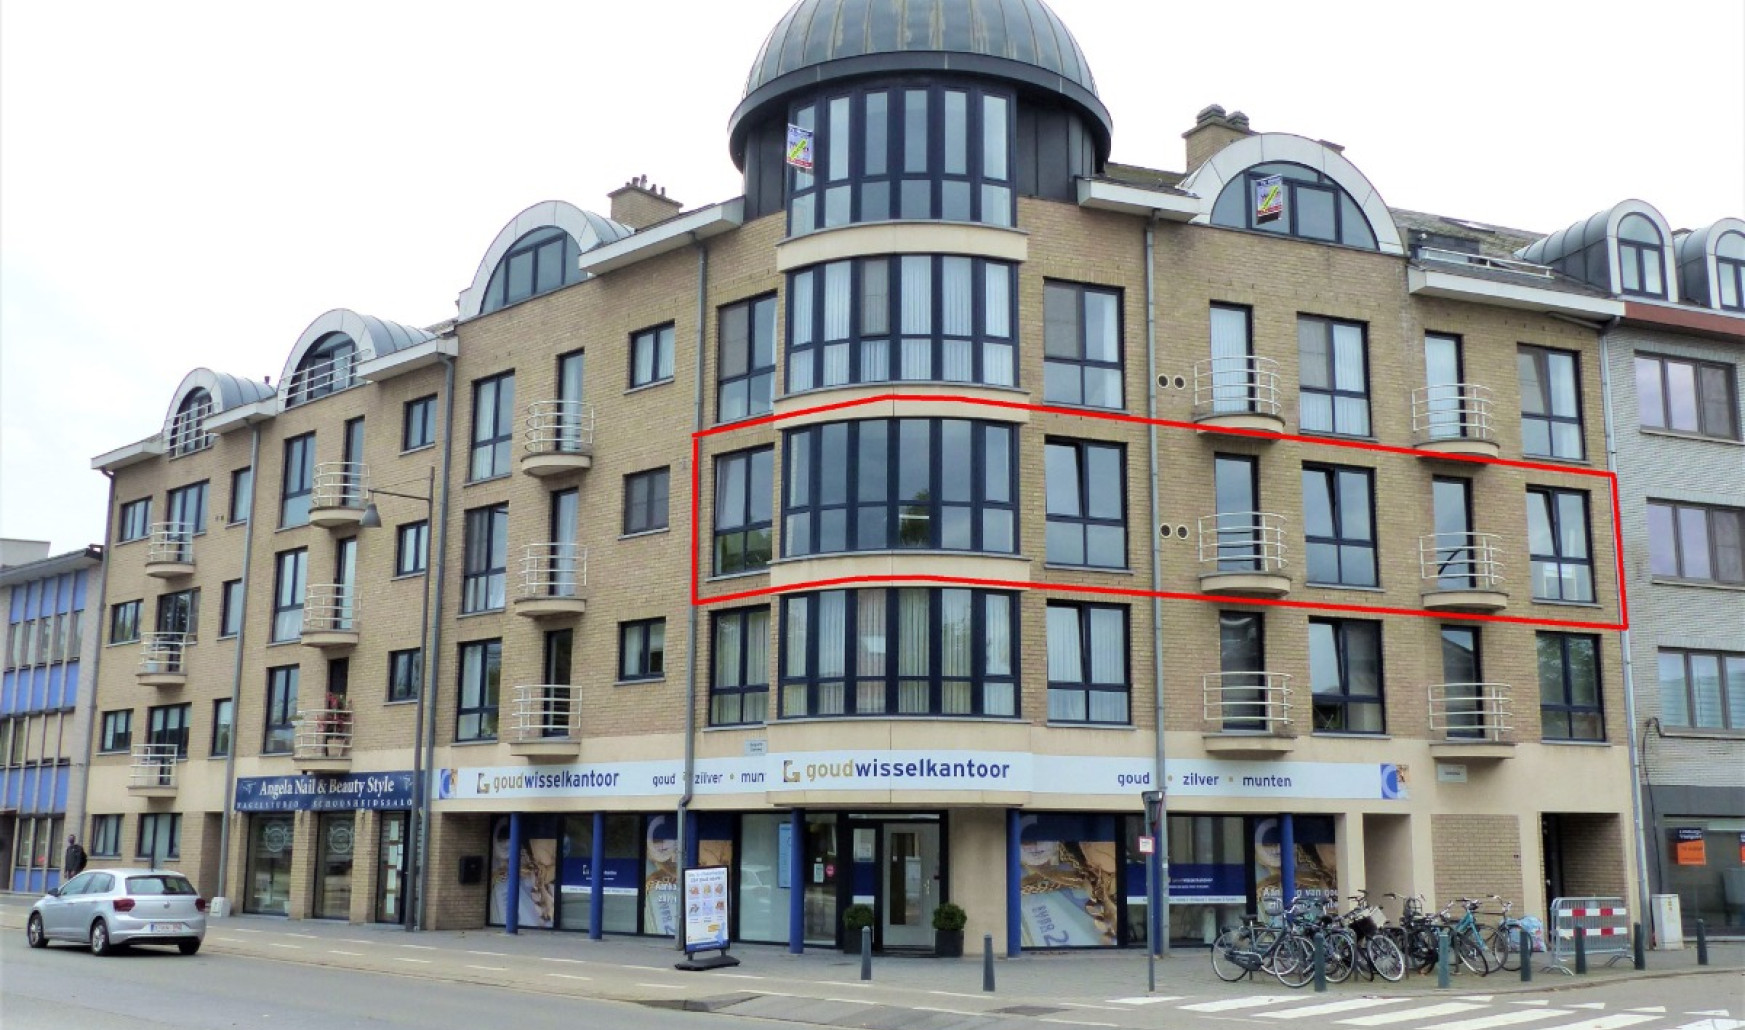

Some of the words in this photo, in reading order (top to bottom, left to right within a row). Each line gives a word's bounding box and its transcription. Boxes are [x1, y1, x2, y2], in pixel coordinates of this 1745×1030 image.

[806, 758, 1010, 782] goudwisselkantoor
[493, 769, 619, 793] goudwisselkantoor
[652, 773, 676, 787] goud
[694, 771, 723, 784] zilver
[741, 771, 766, 783] mun
[1117, 771, 1150, 787] goud
[1183, 772, 1219, 786] zilver
[1242, 774, 1292, 787] munten
[259, 778, 293, 800] Angela
[295, 777, 316, 795] Nail
[317, 778, 328, 795] &
[329, 776, 366, 797] Beauty
[367, 775, 395, 797] Style
[313, 798, 413, 808] SCHOONHEIDSSALO
[1324, 889, 1338, 898] gou
